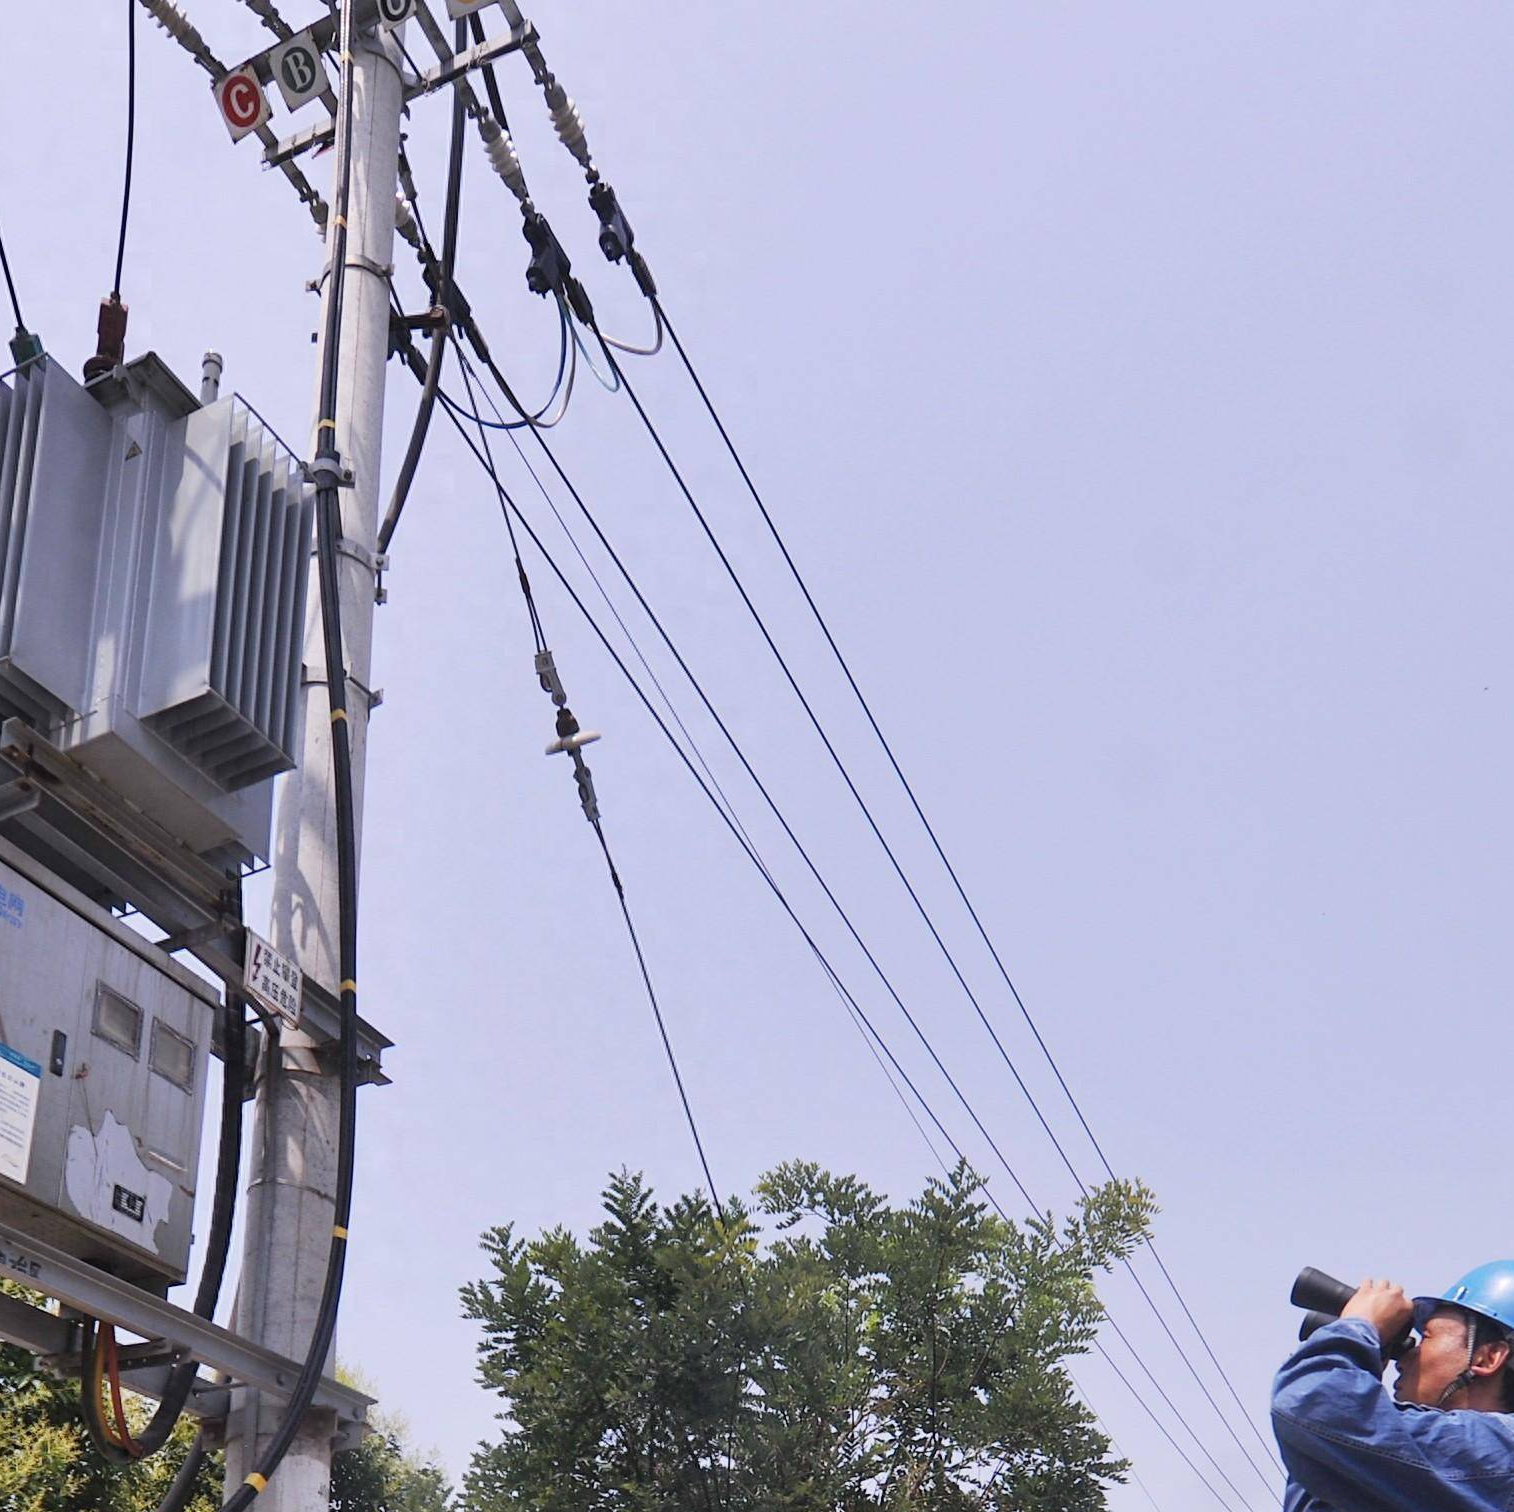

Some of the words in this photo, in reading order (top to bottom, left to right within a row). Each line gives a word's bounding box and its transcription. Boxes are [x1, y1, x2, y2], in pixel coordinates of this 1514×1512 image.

[289, 51, 312, 91] B
[229, 83, 254, 119] C
[261, 975, 296, 1017] 高压危险
